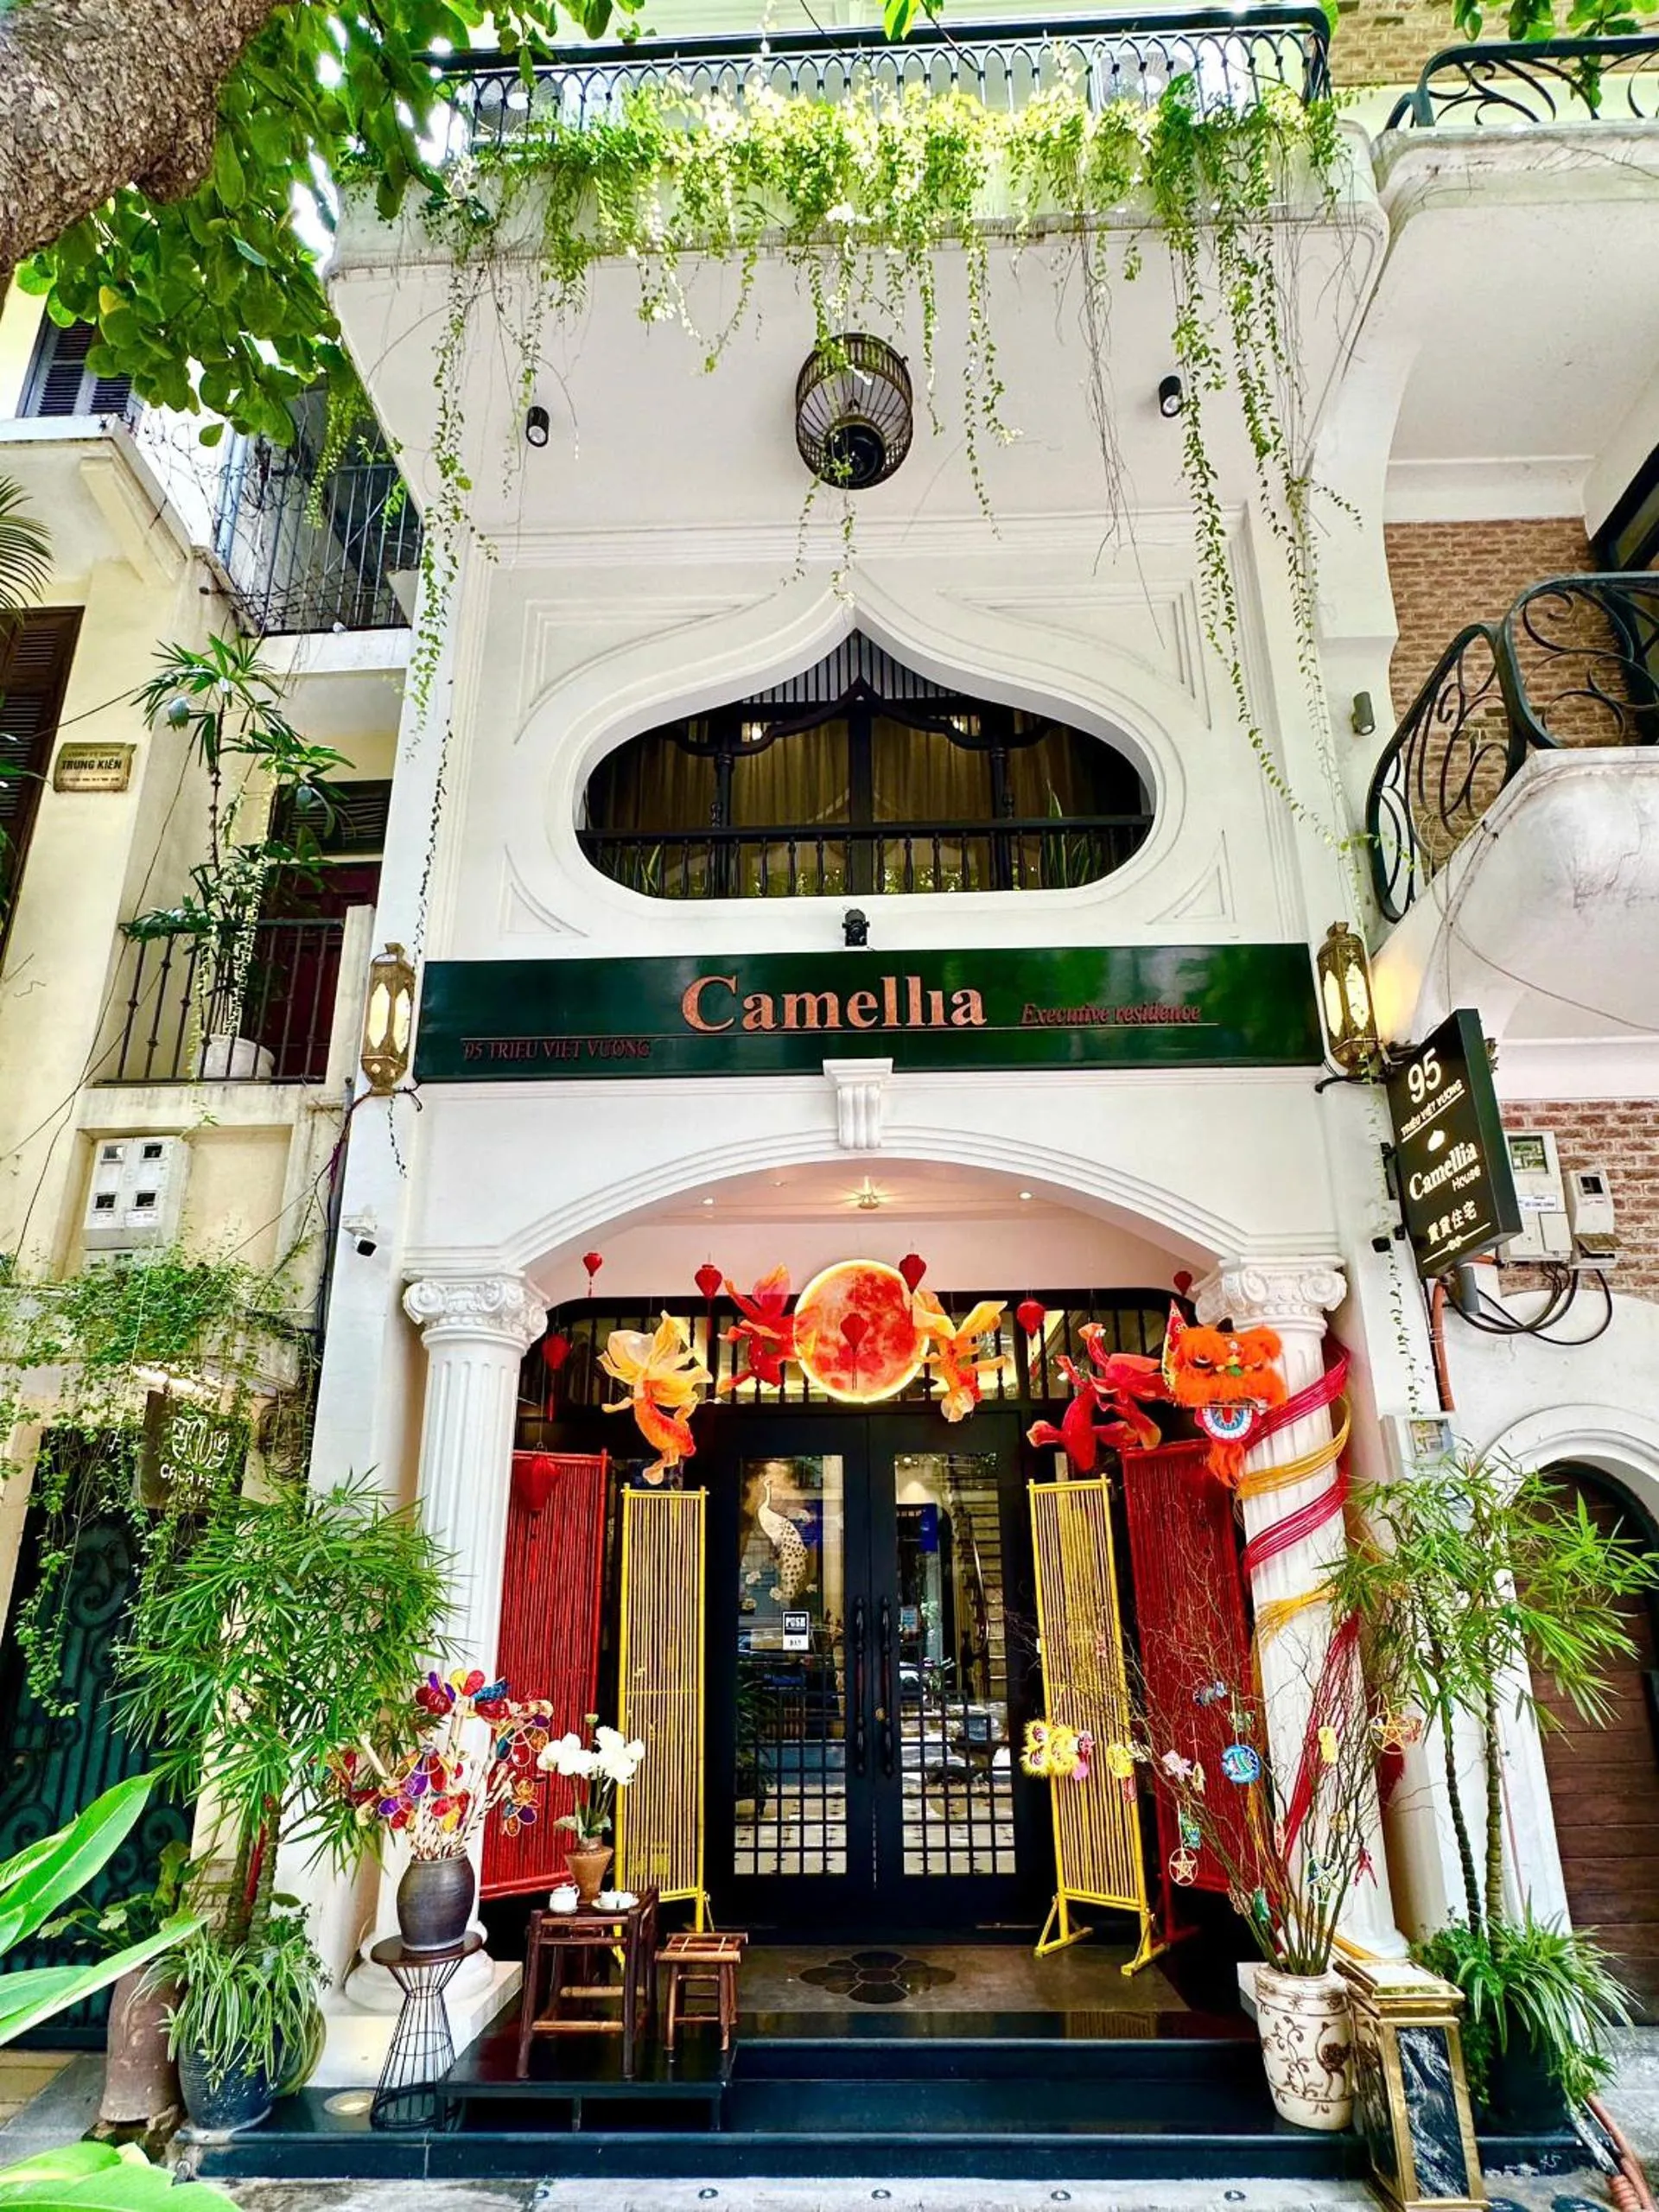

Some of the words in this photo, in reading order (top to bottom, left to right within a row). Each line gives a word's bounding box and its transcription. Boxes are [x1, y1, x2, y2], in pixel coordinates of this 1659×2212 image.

[681, 975, 988, 1032] Camellia
[1021, 1003, 1109, 1026] Executive
[1114, 1003, 1201, 1023] residence
[1408, 1047, 1441, 1103] 95
[1409, 1142, 1478, 1201] Camellia
[1452, 1165, 1481, 1192] House
[785, 1617, 806, 1627] PUSH
